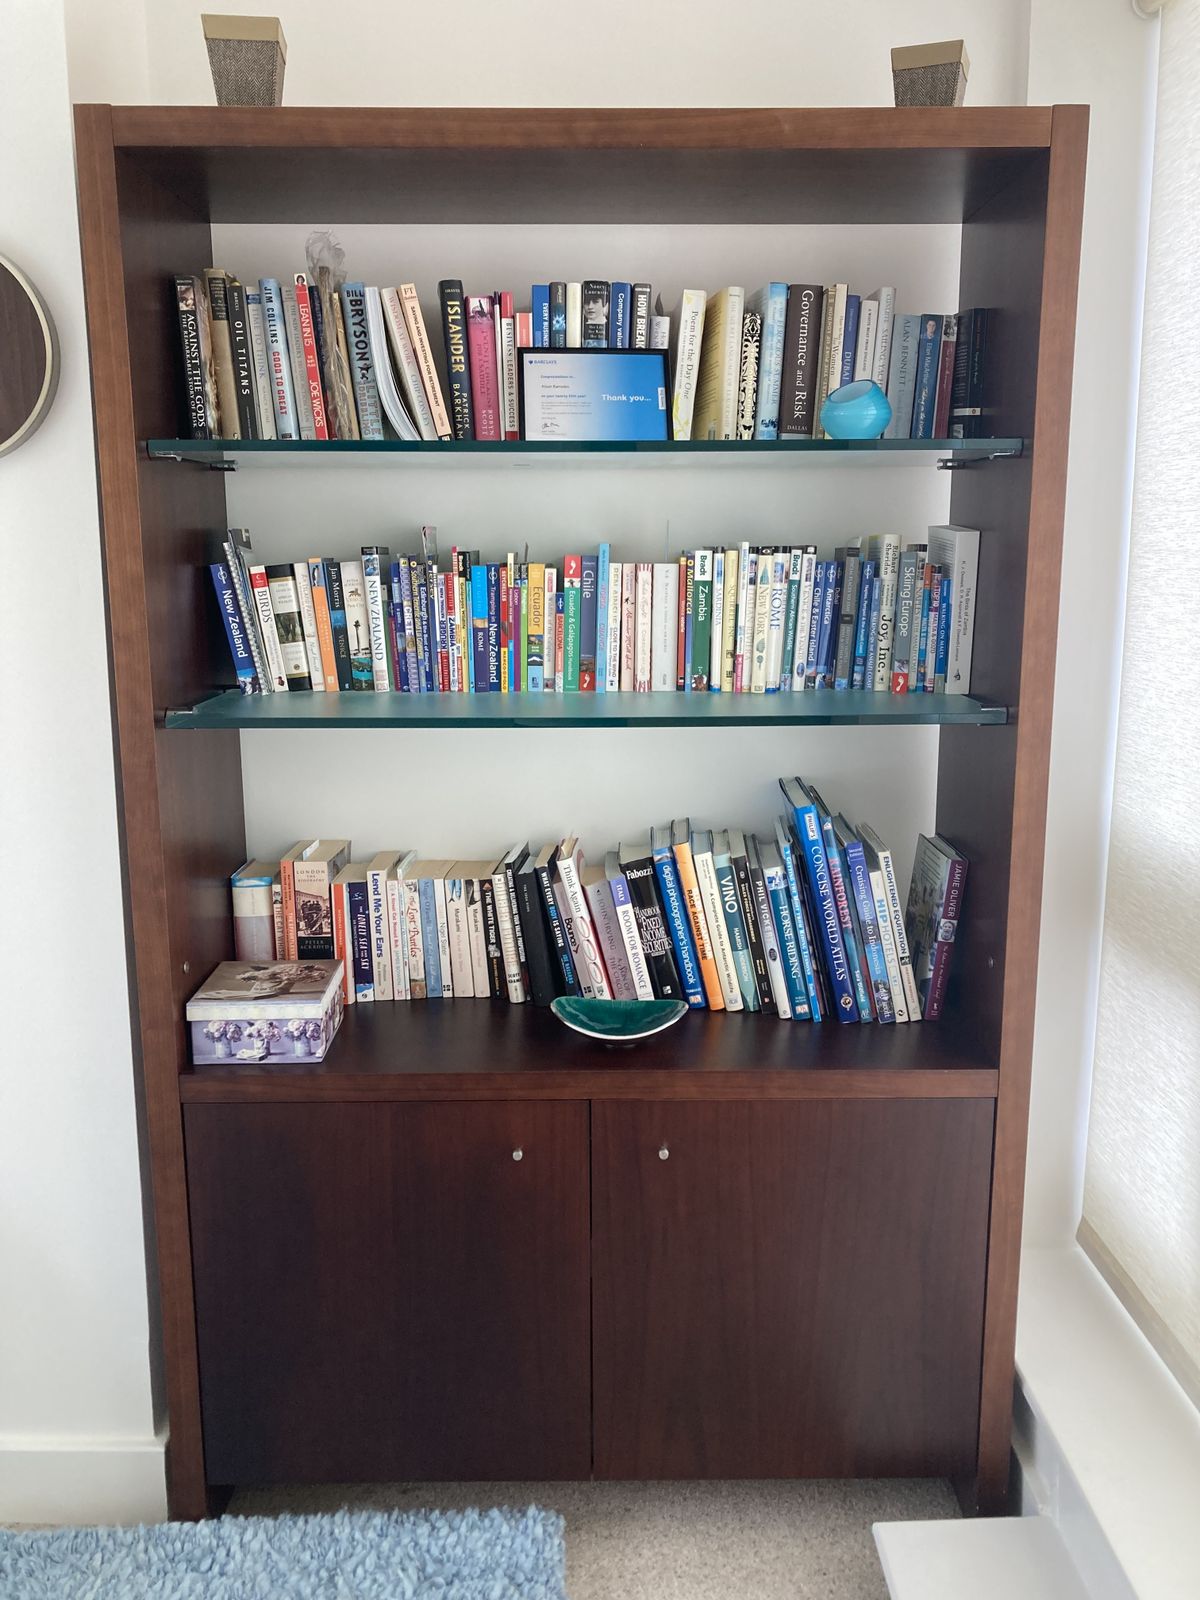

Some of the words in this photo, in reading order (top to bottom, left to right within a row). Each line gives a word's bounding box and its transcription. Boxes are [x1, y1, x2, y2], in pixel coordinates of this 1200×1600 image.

[264, 287, 273, 304] JIM
[637, 295, 647, 316] HOW
[267, 308, 278, 344] COLLINS
[299, 304, 311, 328] LEAN
[410, 306, 419, 325] SAVING
[689, 311, 699, 333] Poem
[797, 290, 814, 365] Governance
[187, 314, 200, 366] AGAINST
[234, 321, 243, 342] OIL
[302, 328, 312, 337] IN
[304, 338, 313, 346] 15
[350, 299, 369, 361] BRYSON
[414, 326, 422, 337] AND
[447, 301, 465, 373] ISLANDER
[903, 319, 911, 342] ALAN
[272, 351, 282, 373] GOOD
[418, 337, 428, 364] INVESTING
[687, 349, 695, 361] the
[238, 348, 249, 395] TITANS
[684, 364, 694, 379] Day
[796, 370, 805, 386] and
[843, 351, 852, 380] DUBAI
[899, 345, 909, 386] BENNETT
[192, 368, 201, 392] THE
[275, 376, 283, 386] TO
[309, 380, 319, 398] JOE
[427, 376, 439, 407] RETIREMENT
[684, 382, 692, 399] One
[195, 395, 205, 427] GODS
[277, 390, 287, 415] GREAT
[313, 399, 323, 427] WICKS
[452, 383, 464, 439] BARKHAM
[794, 391, 806, 418] Risk
[883, 543, 892, 576] Sheridan
[329, 567, 337, 580] Jan
[583, 571, 594, 598] Chile
[900, 567, 914, 599] Skiing
[257, 590, 272, 623] BIRDS
[332, 582, 342, 608] Morris
[368, 580, 377, 607] NEW
[532, 586, 542, 627] Ecuador
[698, 585, 708, 621] Zambia
[758, 586, 768, 609] NEW
[812, 588, 821, 607] Chile
[823, 588, 834, 625] Antarctica
[404, 607, 414, 636] CRETE
[770, 588, 782, 630] ROME
[899, 600, 911, 637] Europe
[222, 589, 235, 613] New
[229, 616, 248, 658] Zealand
[371, 610, 384, 661] ZEALAND
[489, 624, 497, 645] New
[757, 610, 767, 635] YORK
[809, 615, 819, 638] Easter
[878, 614, 892, 642] Joy,
[940, 630, 946, 640] ON
[808, 639, 816, 661] Island
[878, 647, 890, 673] Inc.
[490, 645, 498, 682] Zealand
[371, 873, 382, 896] Lend
[626, 866, 653, 880] Fabozzi
[662, 865, 678, 889] digital
[855, 865, 866, 899] Cruising
[951, 863, 963, 887] JAMIE
[485, 891, 493, 903] THE
[544, 888, 554, 905] EVERY
[563, 864, 575, 889] Think
[569, 890, 583, 913] Again
[617, 884, 625, 902] ITALY
[828, 857, 852, 930] RAINFOREST
[373, 898, 382, 913] Me
[548, 906, 556, 920] BODY
[810, 846, 827, 897] CONCISE
[820, 898, 839, 944] WORLD
[830, 945, 846, 981] ATLAS
[858, 900, 870, 924] Guide
[876, 898, 888, 923] HIP
[883, 856, 898, 909] ENLIGHTENED
[893, 909, 907, 955] EQUITATION
[947, 889, 958, 918] OLIVER
[374, 914, 383, 935] Your
[597, 898, 607, 920] JOHN
[604, 922, 617, 950] IRVING
[621, 910, 632, 935] ROOM
[667, 889, 689, 945] photographer's
[687, 889, 695, 909] RACE
[691, 910, 702, 942] AGAINST
[698, 943, 707, 961] TIME
[720, 875, 738, 913] VINO
[734, 927, 742, 950] HAMISH
[739, 951, 749, 982] ANDERSON
[779, 904, 793, 941] HORSE
[554, 927, 564, 947] SAYING
[564, 917, 577, 947] Bounce
[627, 936, 637, 951] FOR
[865, 926, 874, 935] to
[376, 937, 384, 958] Ears
[867, 936, 882, 975] Indonesia
[881, 925, 895, 964] HOTELS
[631, 952, 646, 989] ROMANCE
[679, 946, 697, 985] handbook
[785, 942, 800, 979] RIDING
